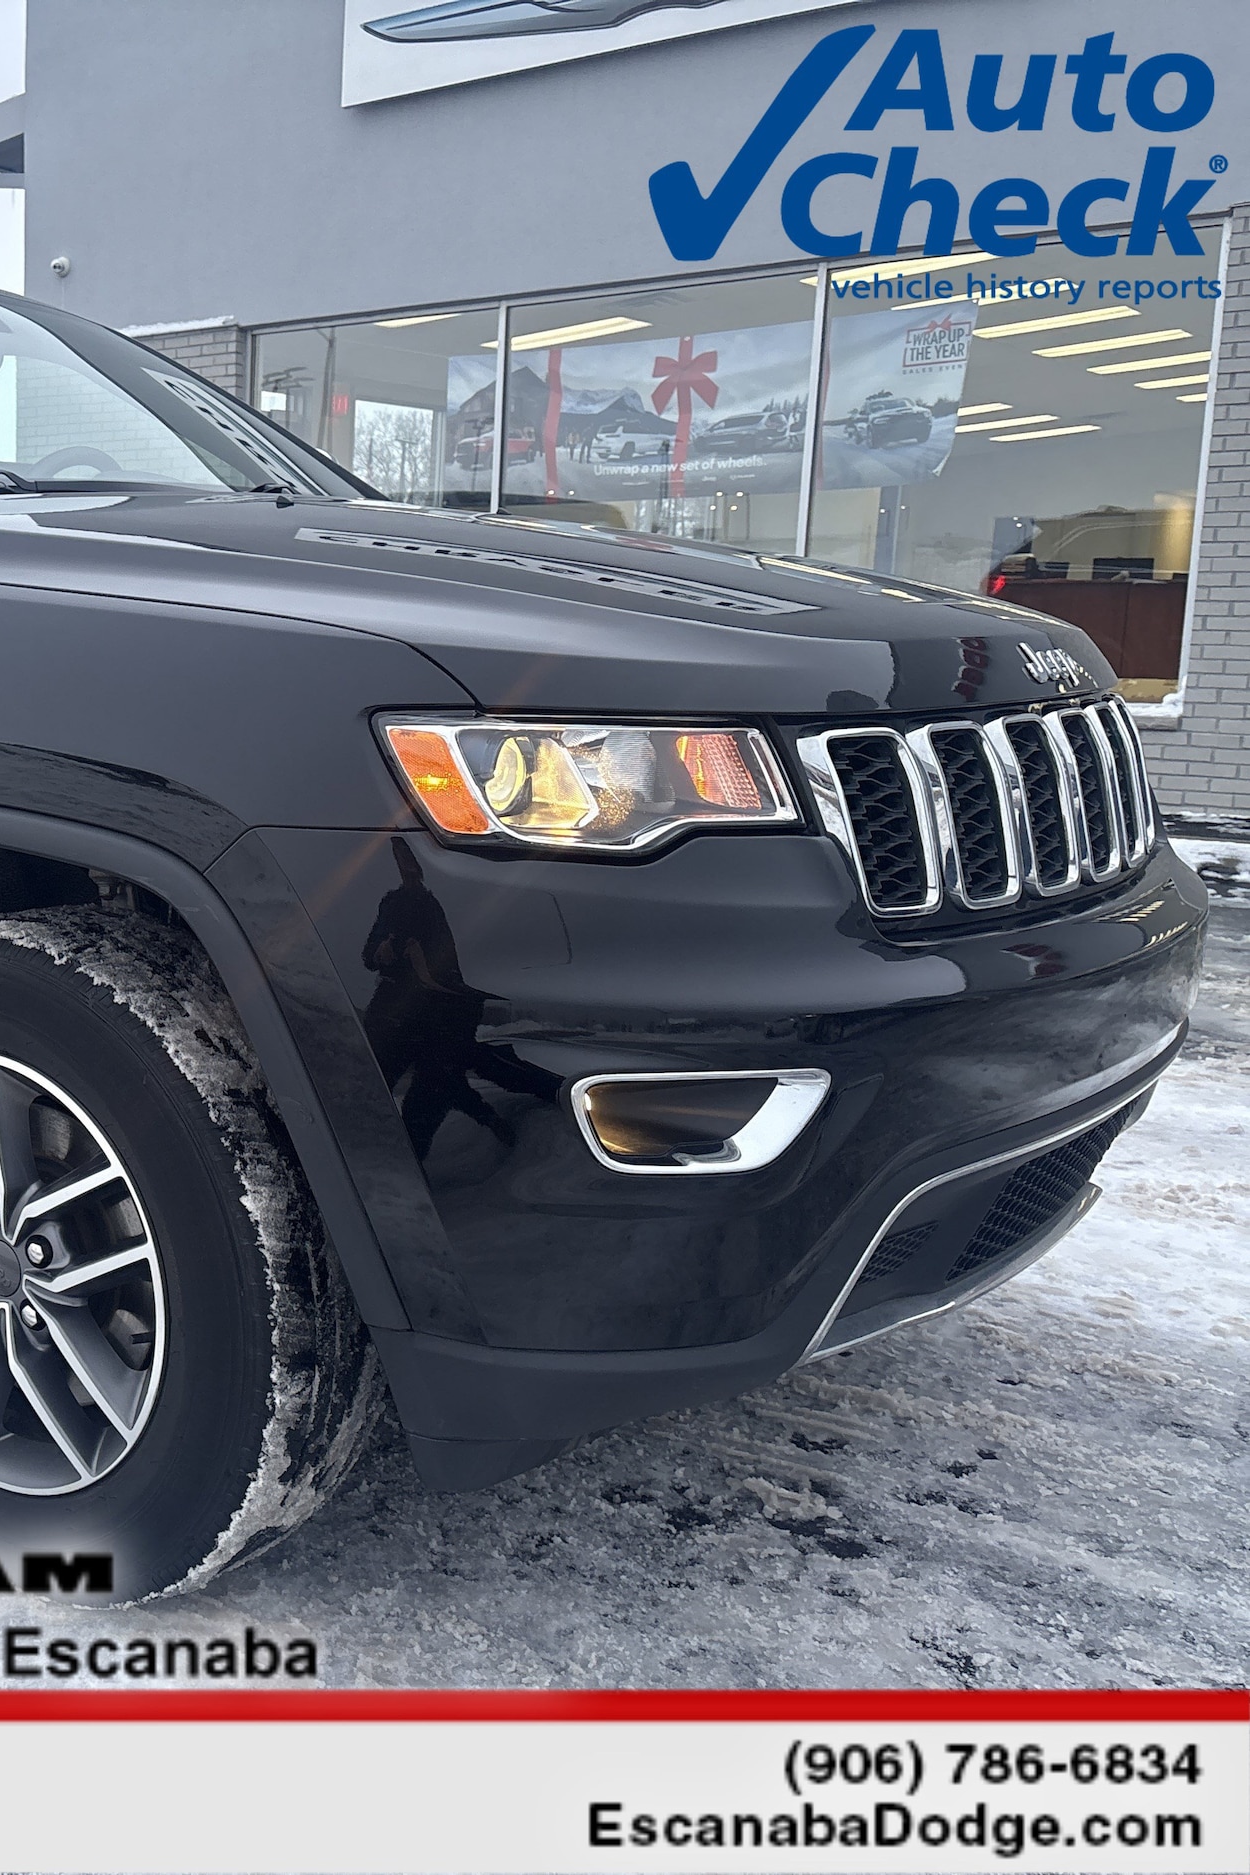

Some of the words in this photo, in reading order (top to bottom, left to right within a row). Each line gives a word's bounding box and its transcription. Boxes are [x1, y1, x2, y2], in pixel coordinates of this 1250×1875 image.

[913, 330, 946, 347] WRAP
[948, 328, 965, 343] UP
[910, 346, 932, 361] THE
[934, 343, 965, 359] YEAR
[594, 463, 639, 477] Unwrap
[641, 465, 649, 474] a
[650, 463, 678, 474] new
[679, 461, 699, 472] set
[701, 457, 715, 471] of
